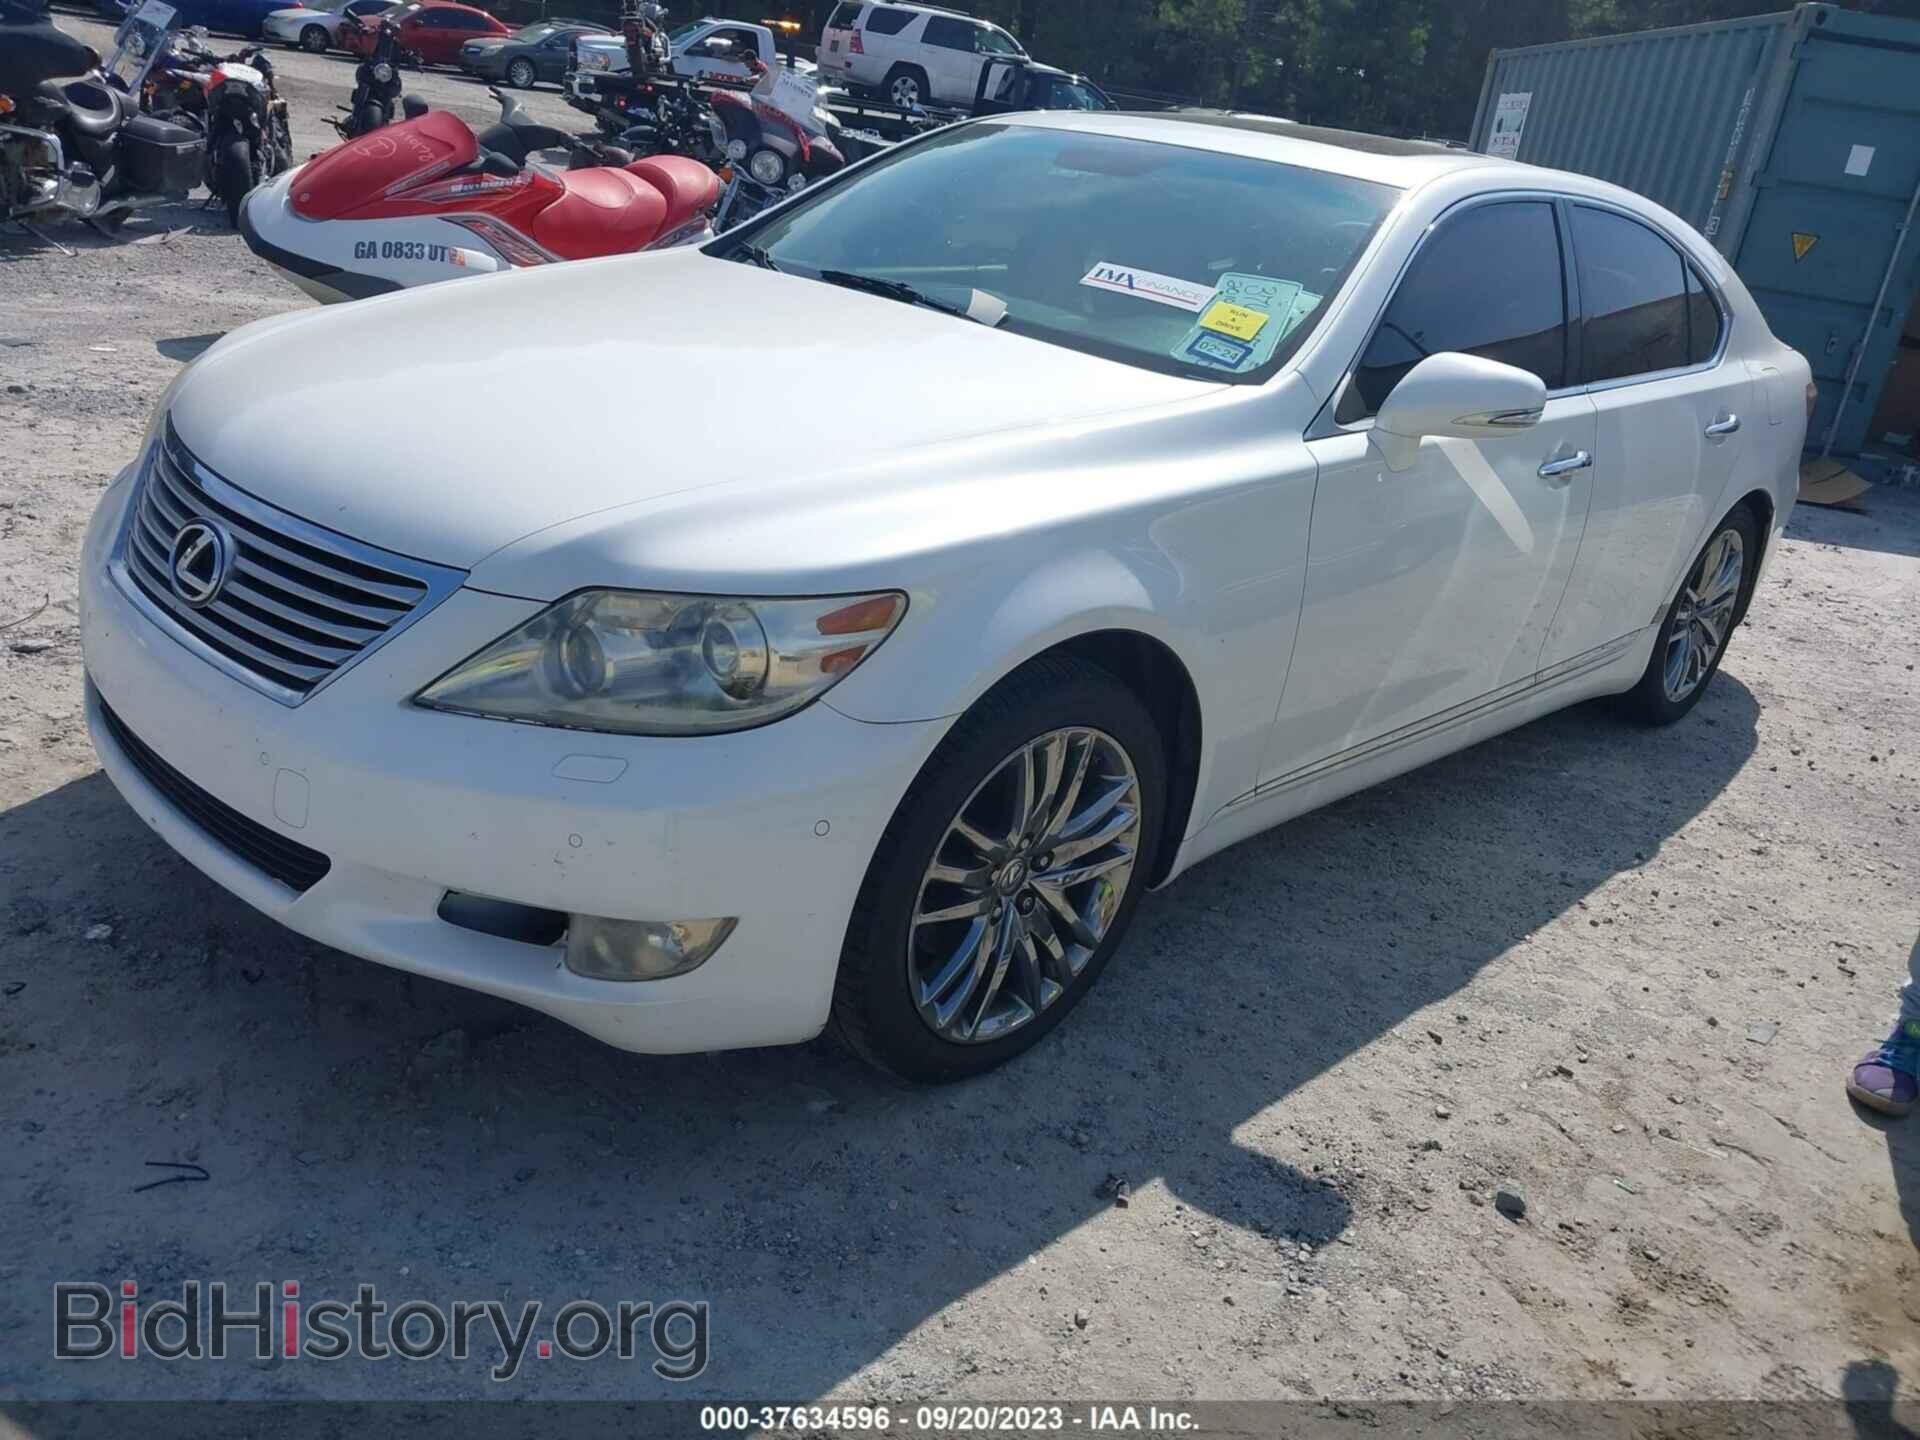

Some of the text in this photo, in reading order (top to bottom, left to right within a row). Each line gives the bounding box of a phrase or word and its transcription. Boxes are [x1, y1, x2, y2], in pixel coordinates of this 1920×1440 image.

[354, 241, 449, 262] GA 0833 UT
